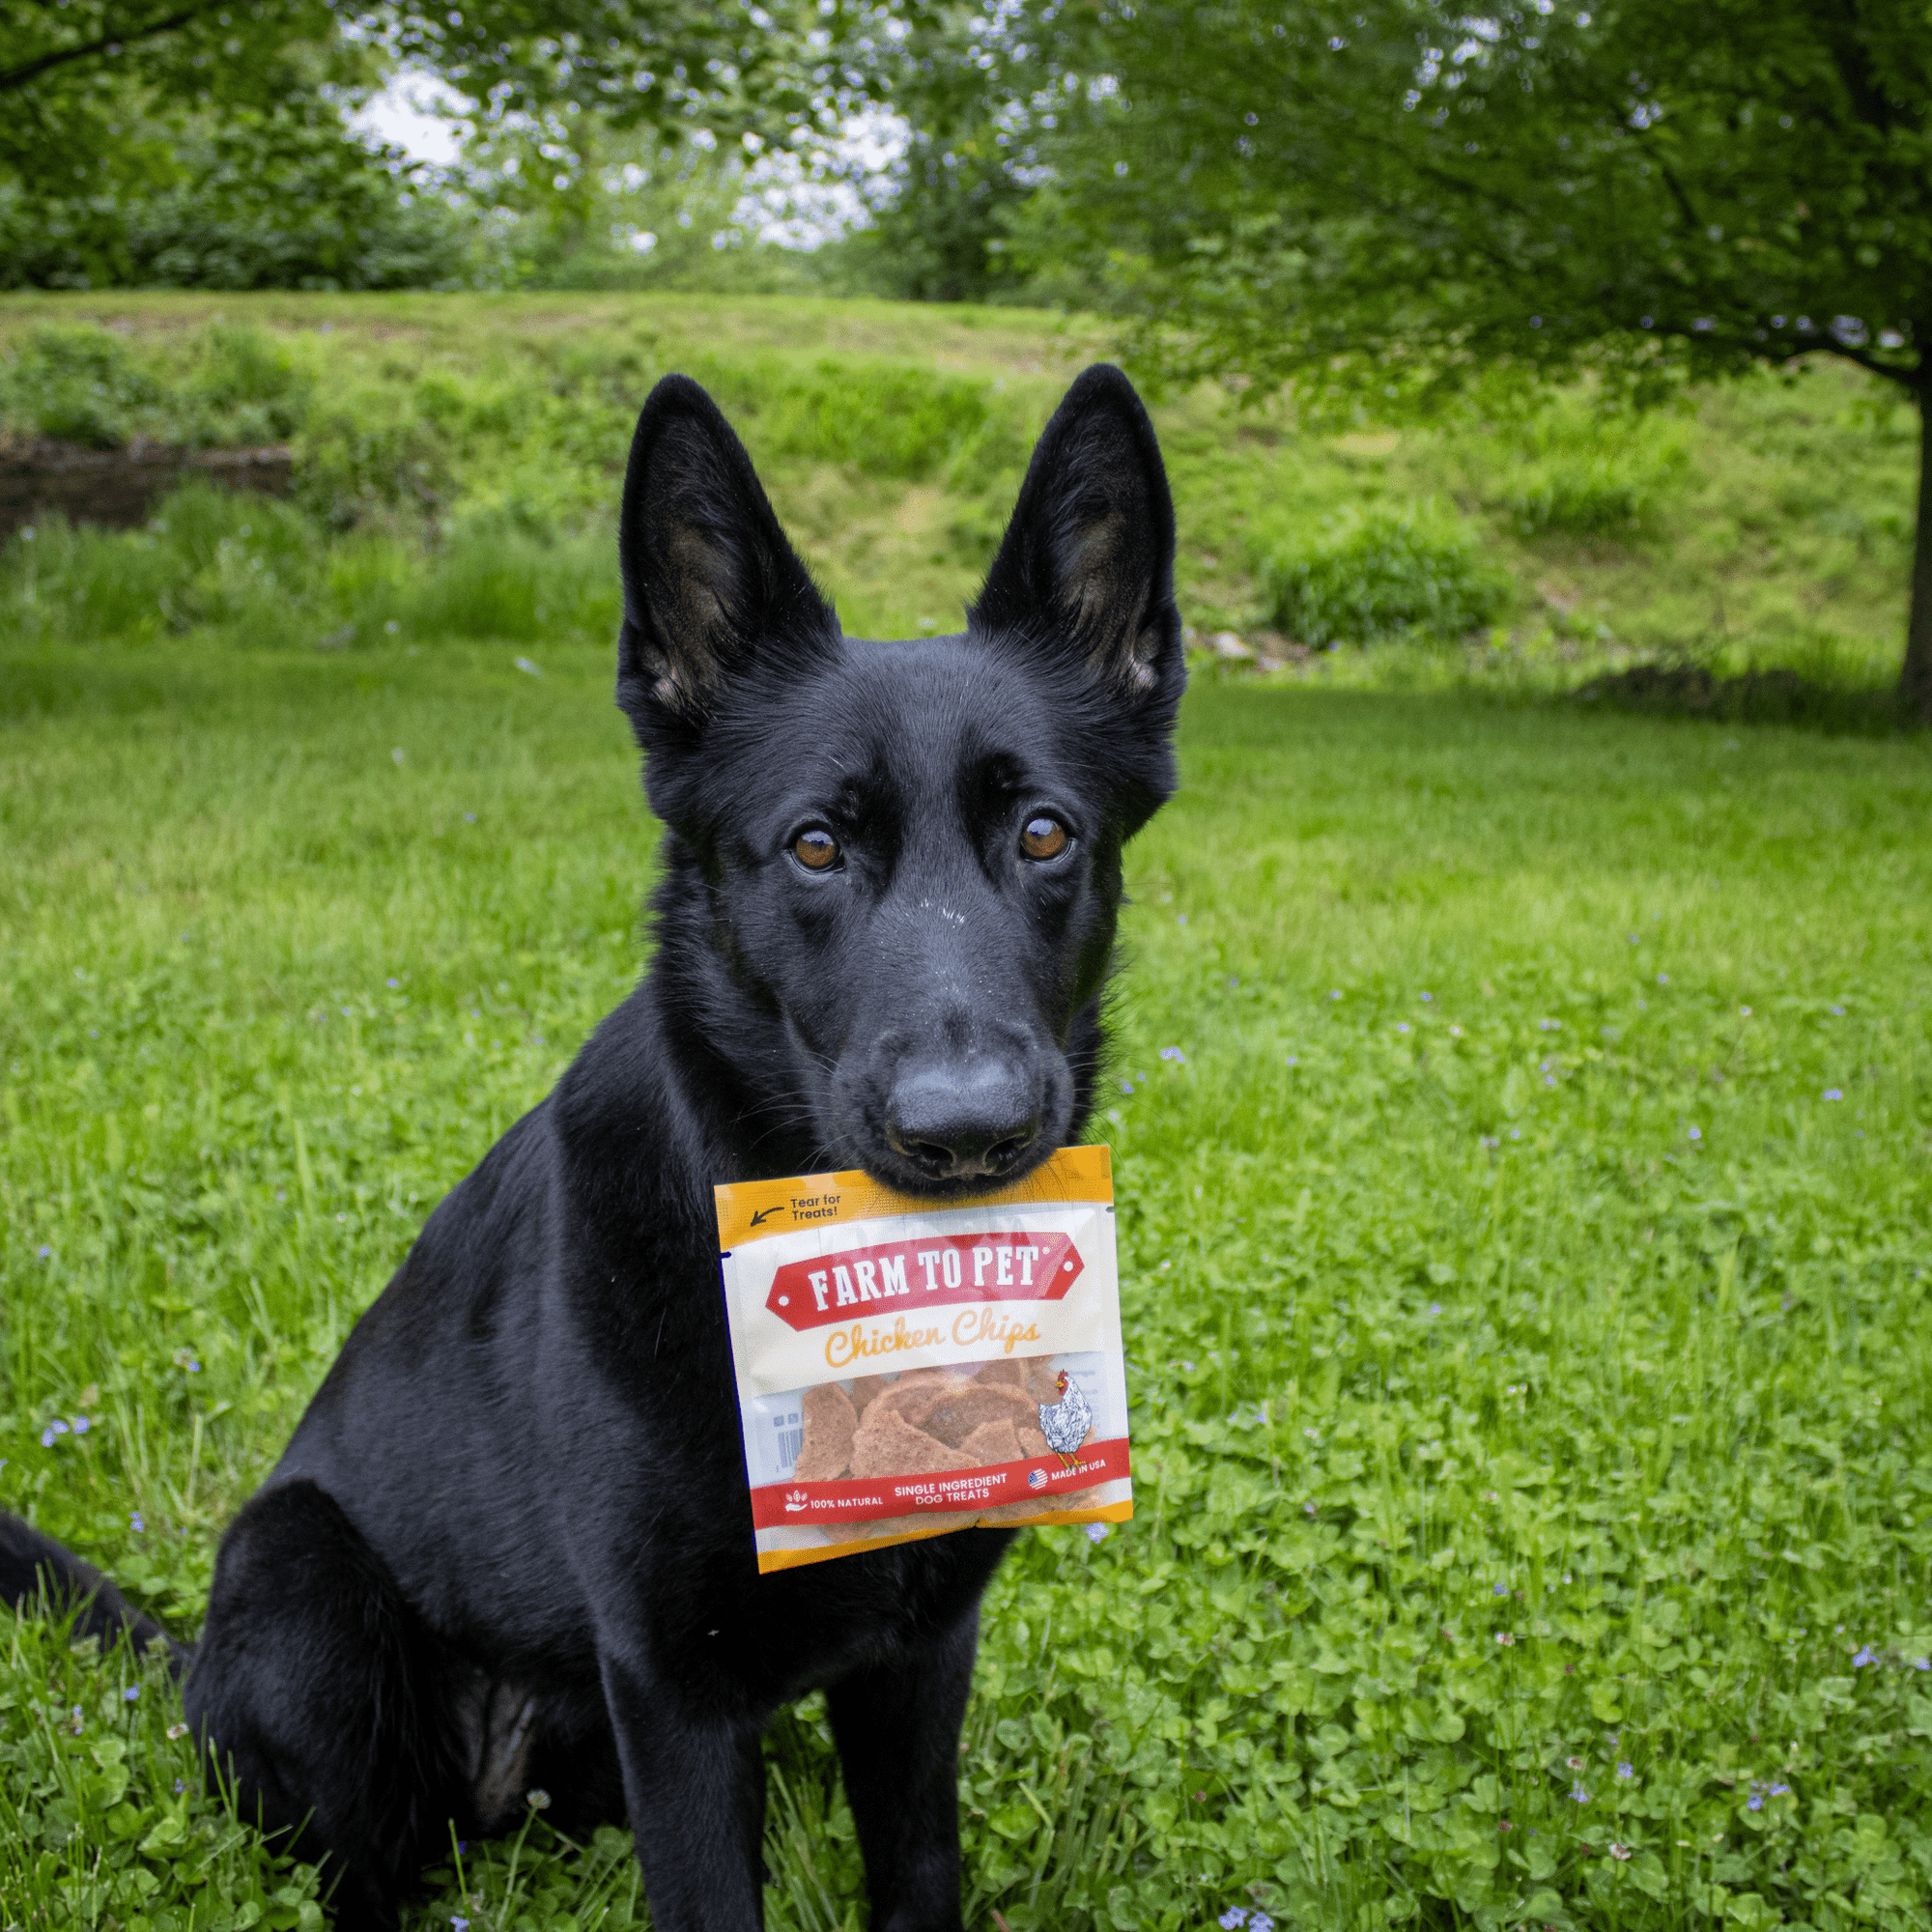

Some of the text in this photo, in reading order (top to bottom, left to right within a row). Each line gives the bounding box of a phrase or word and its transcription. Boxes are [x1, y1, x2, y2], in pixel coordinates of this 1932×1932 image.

[790, 1194, 841, 1208] Tear for
[792, 1206, 838, 1221] Treats!
[808, 1255, 909, 1311] FARM
[918, 1248, 961, 1291] TO
[825, 1307, 1040, 1368] Chicken Chips
[1051, 1460, 1106, 1481] MADE IN USA
[895, 1473, 1008, 1497] SINGLE INGREDIENT
[810, 1496, 884, 1509] 100% NATURAL
[915, 1489, 990, 1505] DOG TREATS
